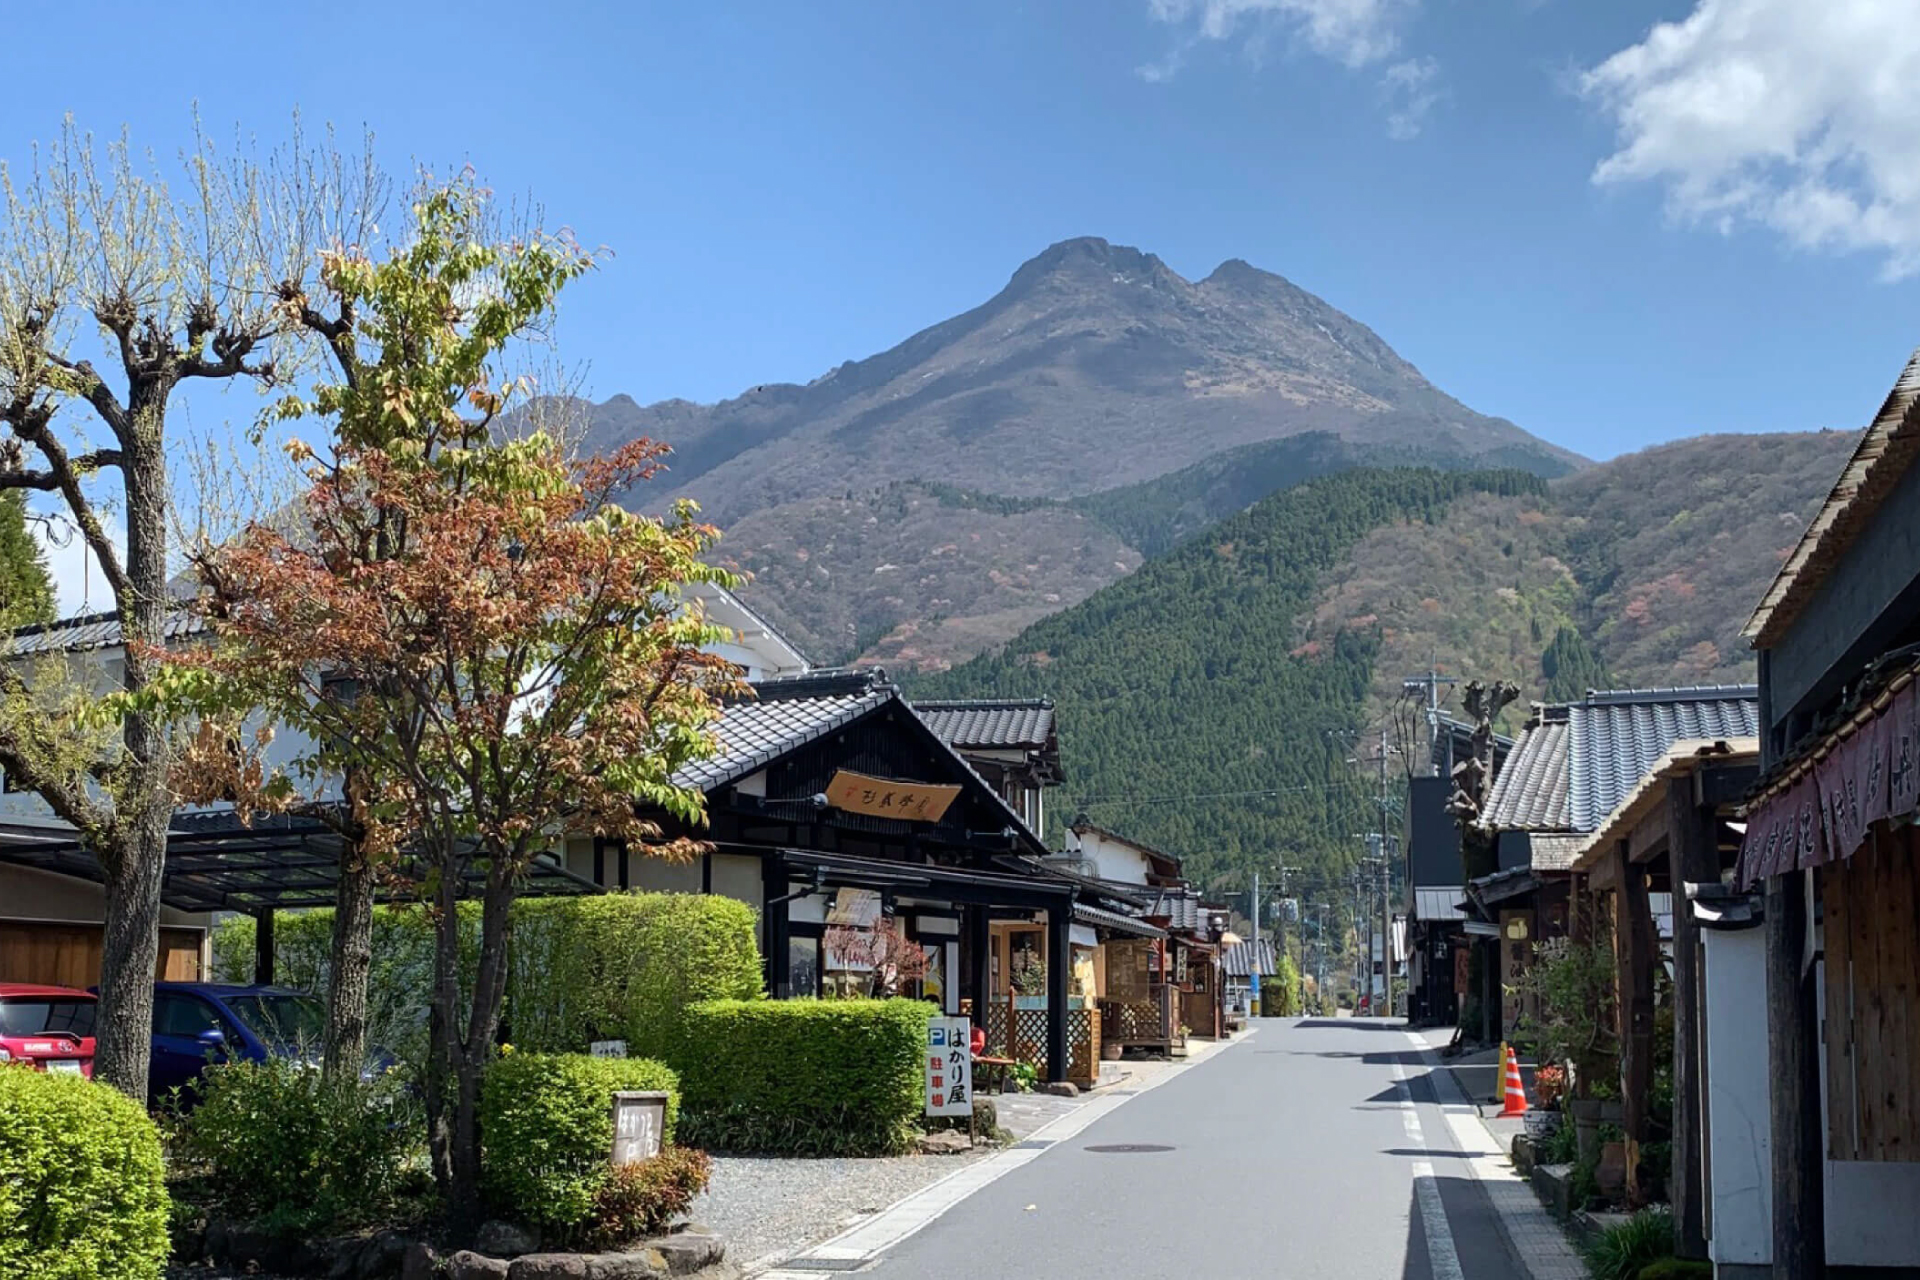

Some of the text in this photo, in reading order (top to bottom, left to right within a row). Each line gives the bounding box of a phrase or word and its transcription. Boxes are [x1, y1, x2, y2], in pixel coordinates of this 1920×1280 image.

[929, 1029, 944, 1045] P
[930, 1057, 944, 1107] 駐車場
[947, 1027, 967, 1105] はかり屋
